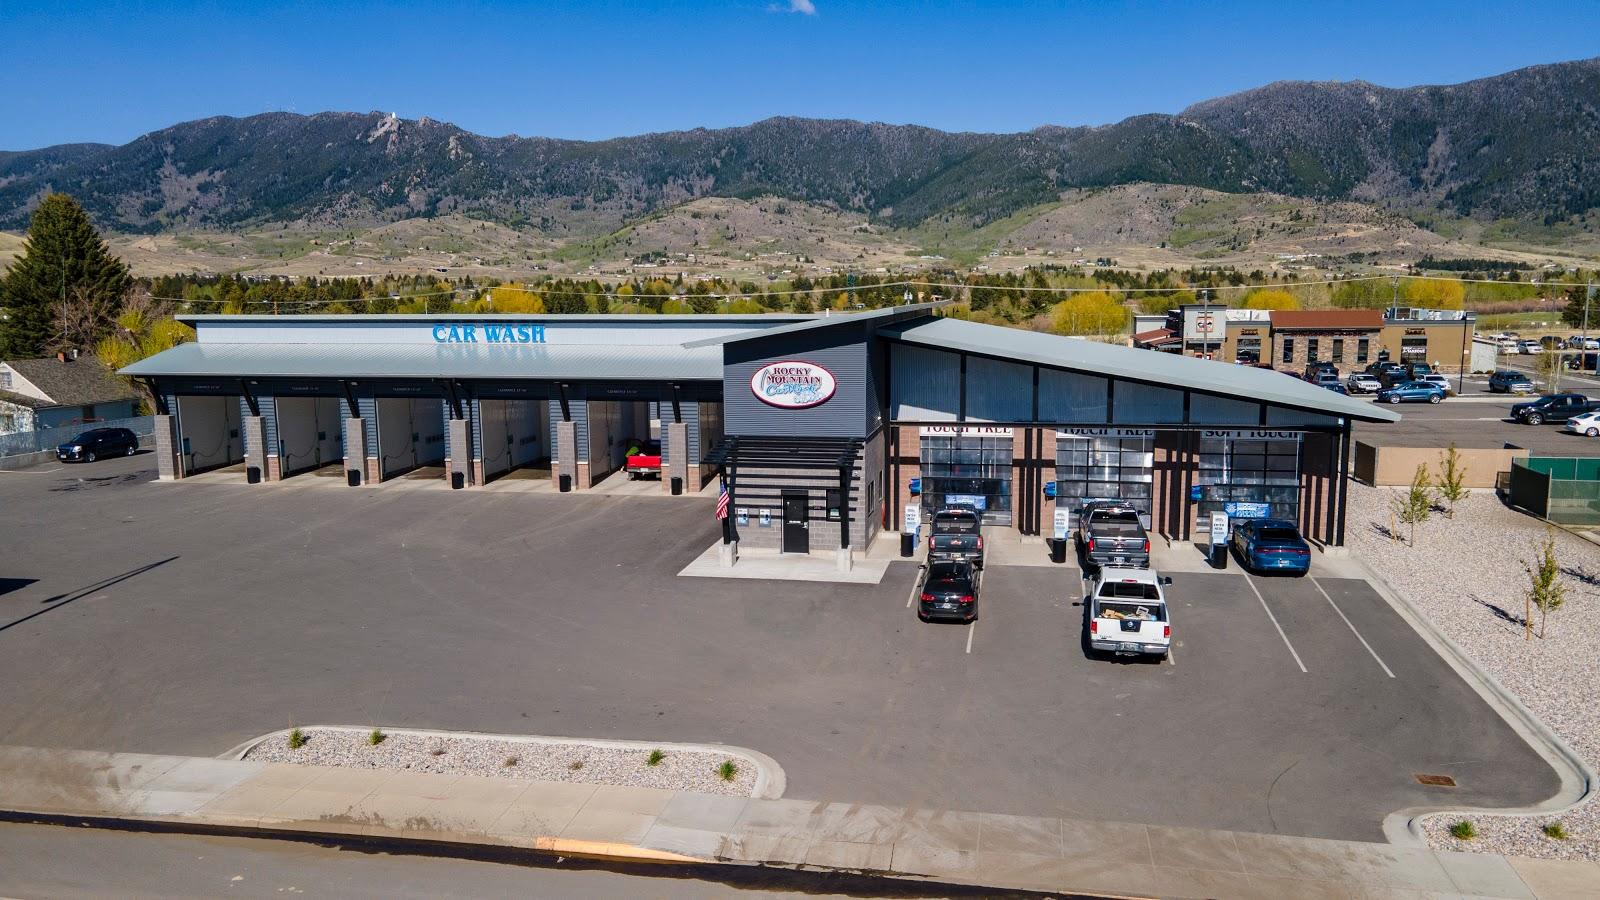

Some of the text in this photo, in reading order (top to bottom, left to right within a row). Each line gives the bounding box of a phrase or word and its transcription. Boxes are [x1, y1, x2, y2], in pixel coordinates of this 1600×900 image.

[432, 324, 546, 343] CAR WASH
[773, 367, 811, 375] ROCKY
[767, 375, 822, 384] MOUNTAIN
